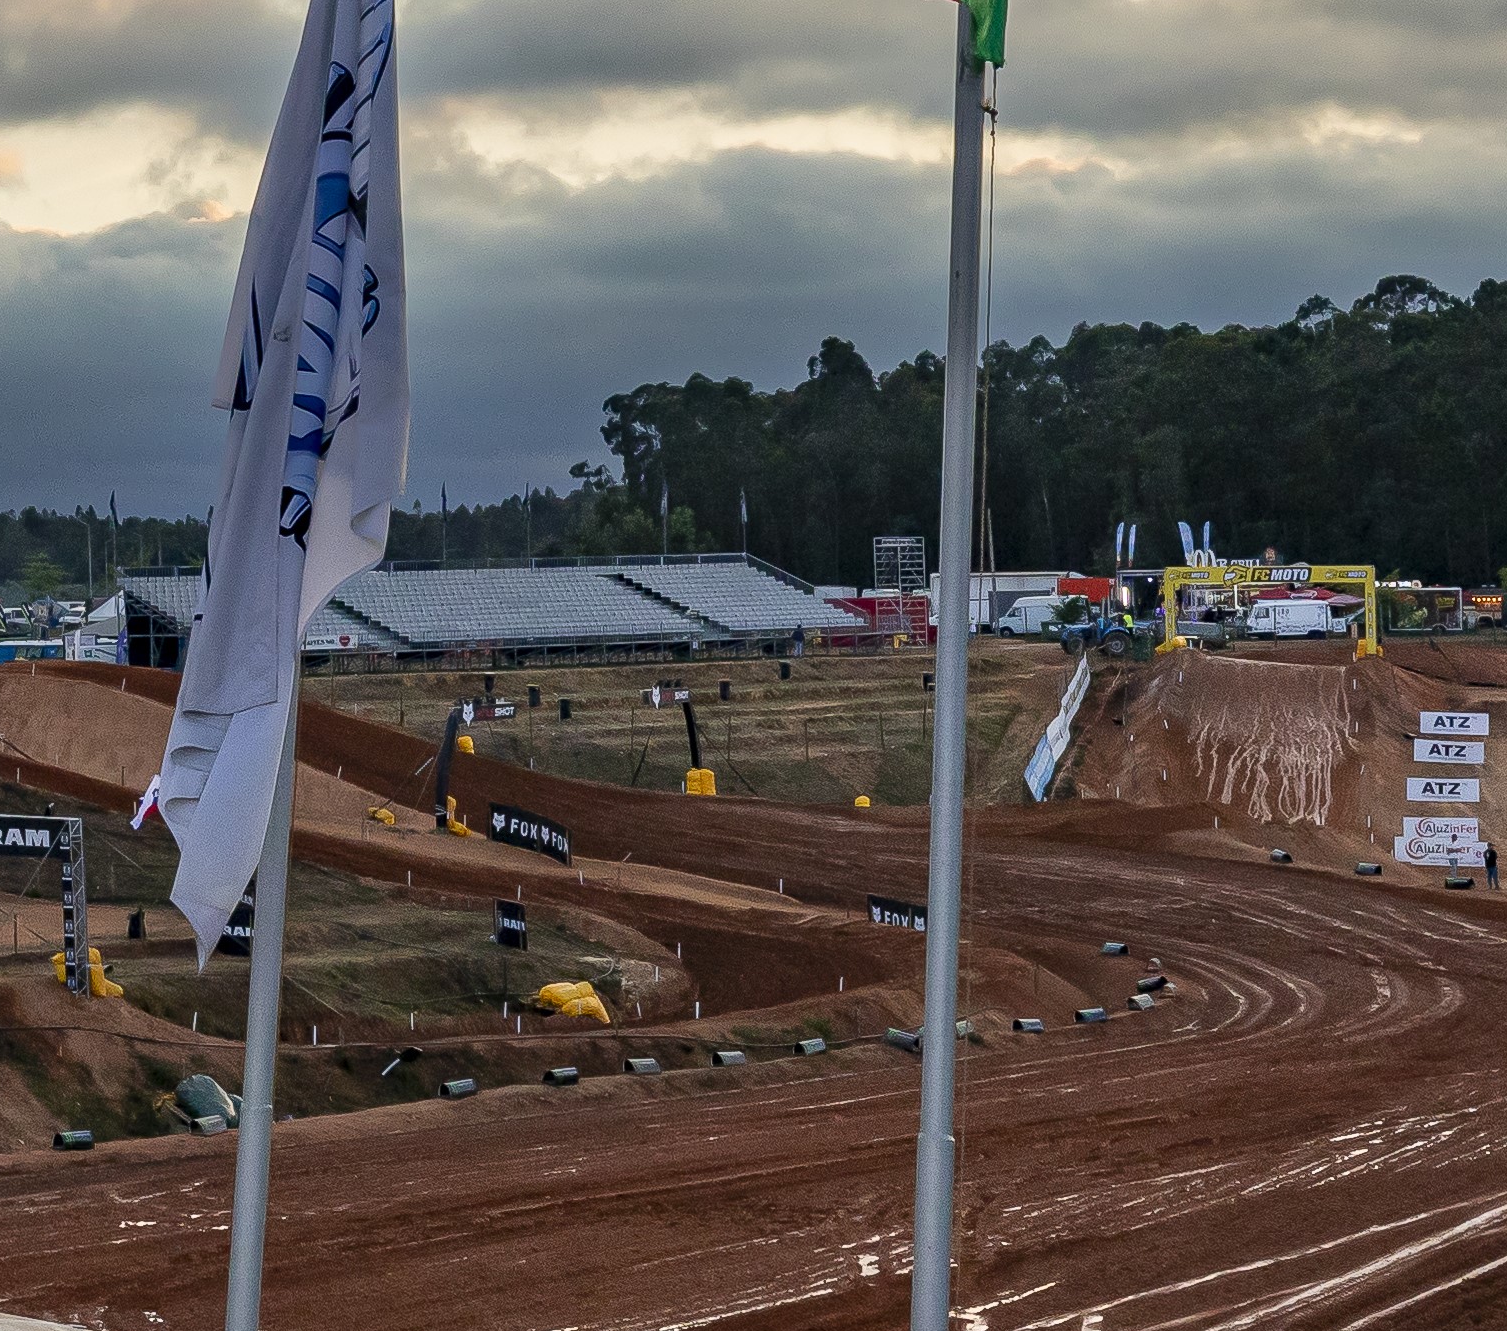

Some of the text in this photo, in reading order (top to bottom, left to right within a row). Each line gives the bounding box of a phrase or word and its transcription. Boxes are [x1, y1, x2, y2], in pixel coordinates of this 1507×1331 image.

[1434, 716, 1470, 728] ATZ
[1429, 744, 1466, 757] ATZ
[1422, 782, 1461, 795] ATZ
[510, 819, 537, 840] FOX
[884, 911, 909, 928] FOX
